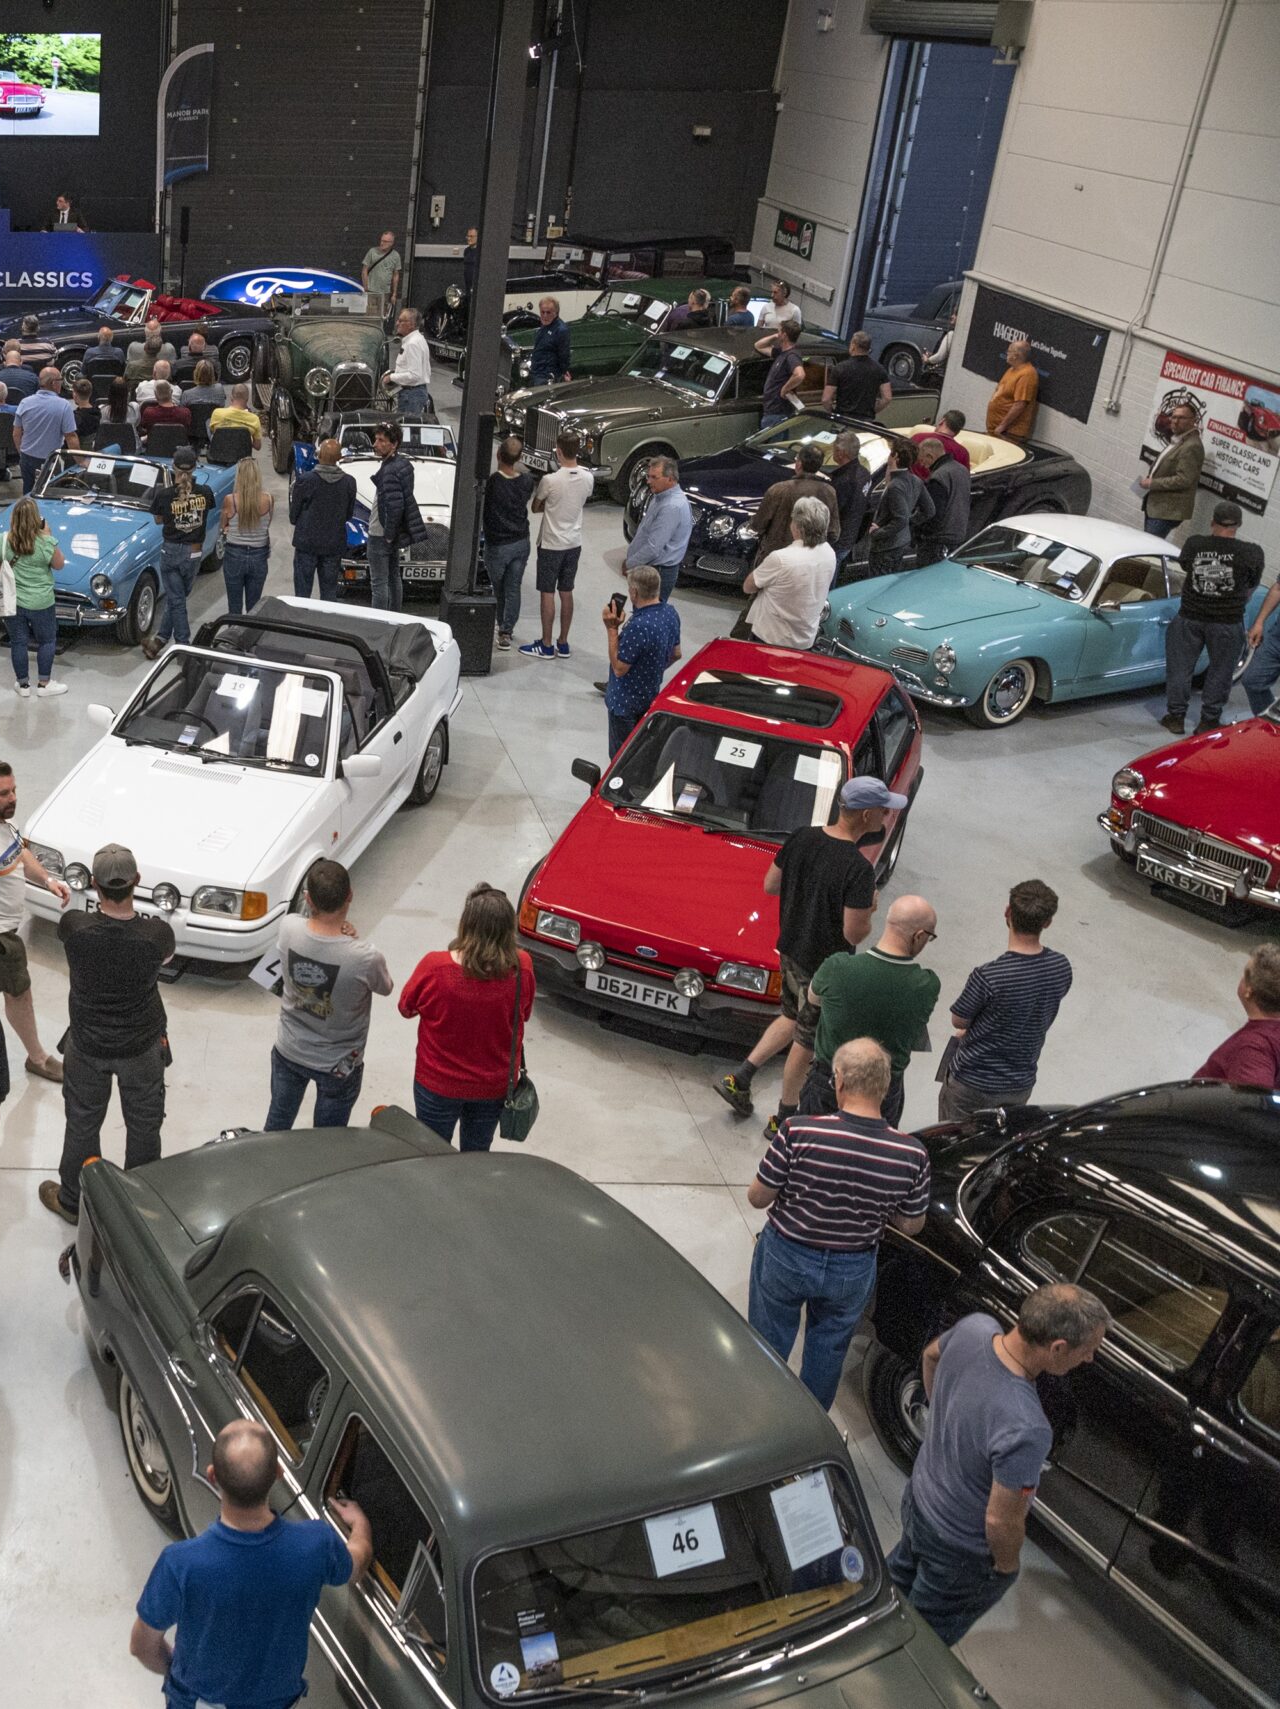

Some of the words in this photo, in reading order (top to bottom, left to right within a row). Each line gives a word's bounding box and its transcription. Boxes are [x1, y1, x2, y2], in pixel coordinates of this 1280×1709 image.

[166, 109, 191, 119] MANOR
[192, 108, 209, 116] PARK
[993, 321, 1029, 343] HAGERTY
[1163, 361, 1202, 385] SPECIALIST
[1200, 372, 1216, 390] CAR
[1215, 374, 1247, 398] FINANCE
[1209, 421, 1233, 437] FINANCE
[1232, 430, 1244, 440] FOR
[1211, 436, 1231, 449] SUPER
[1231, 445, 1258, 463] CLASSIC
[1257, 457, 1271, 468] AND
[1215, 450, 1243, 468] HISTORIC
[1242, 462, 1260, 476] CARS
[729, 746, 747, 759] 25
[1143, 860, 1176, 885] XKR
[1178, 875, 1217, 901] 571A
[596, 975, 638, 999] D621
[642, 988, 680, 1010] FFK
[672, 1528, 700, 1553] 46
